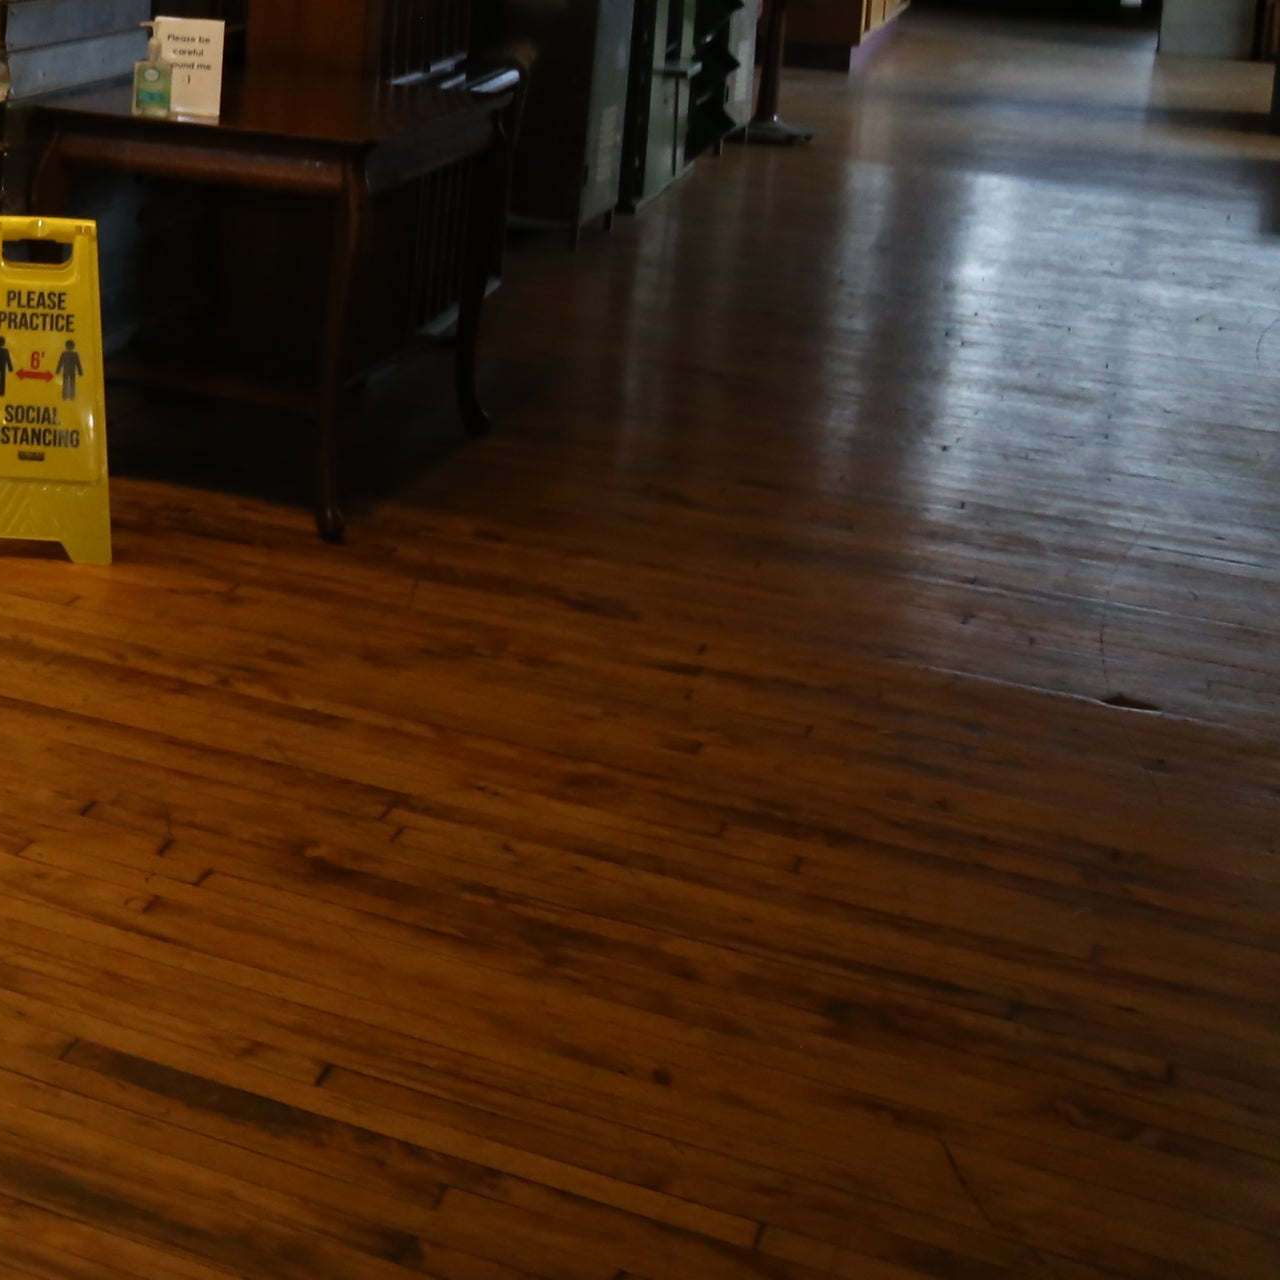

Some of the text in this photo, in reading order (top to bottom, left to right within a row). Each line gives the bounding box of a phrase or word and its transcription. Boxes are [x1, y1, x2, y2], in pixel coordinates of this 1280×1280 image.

[167, 33, 211, 44] Please be
[172, 48, 204, 57] careful
[196, 63, 212, 71] me
[6, 289, 67, 311] PLEASE
[30, 350, 46, 370] 6'
[4, 403, 62, 426] SOCIAL
